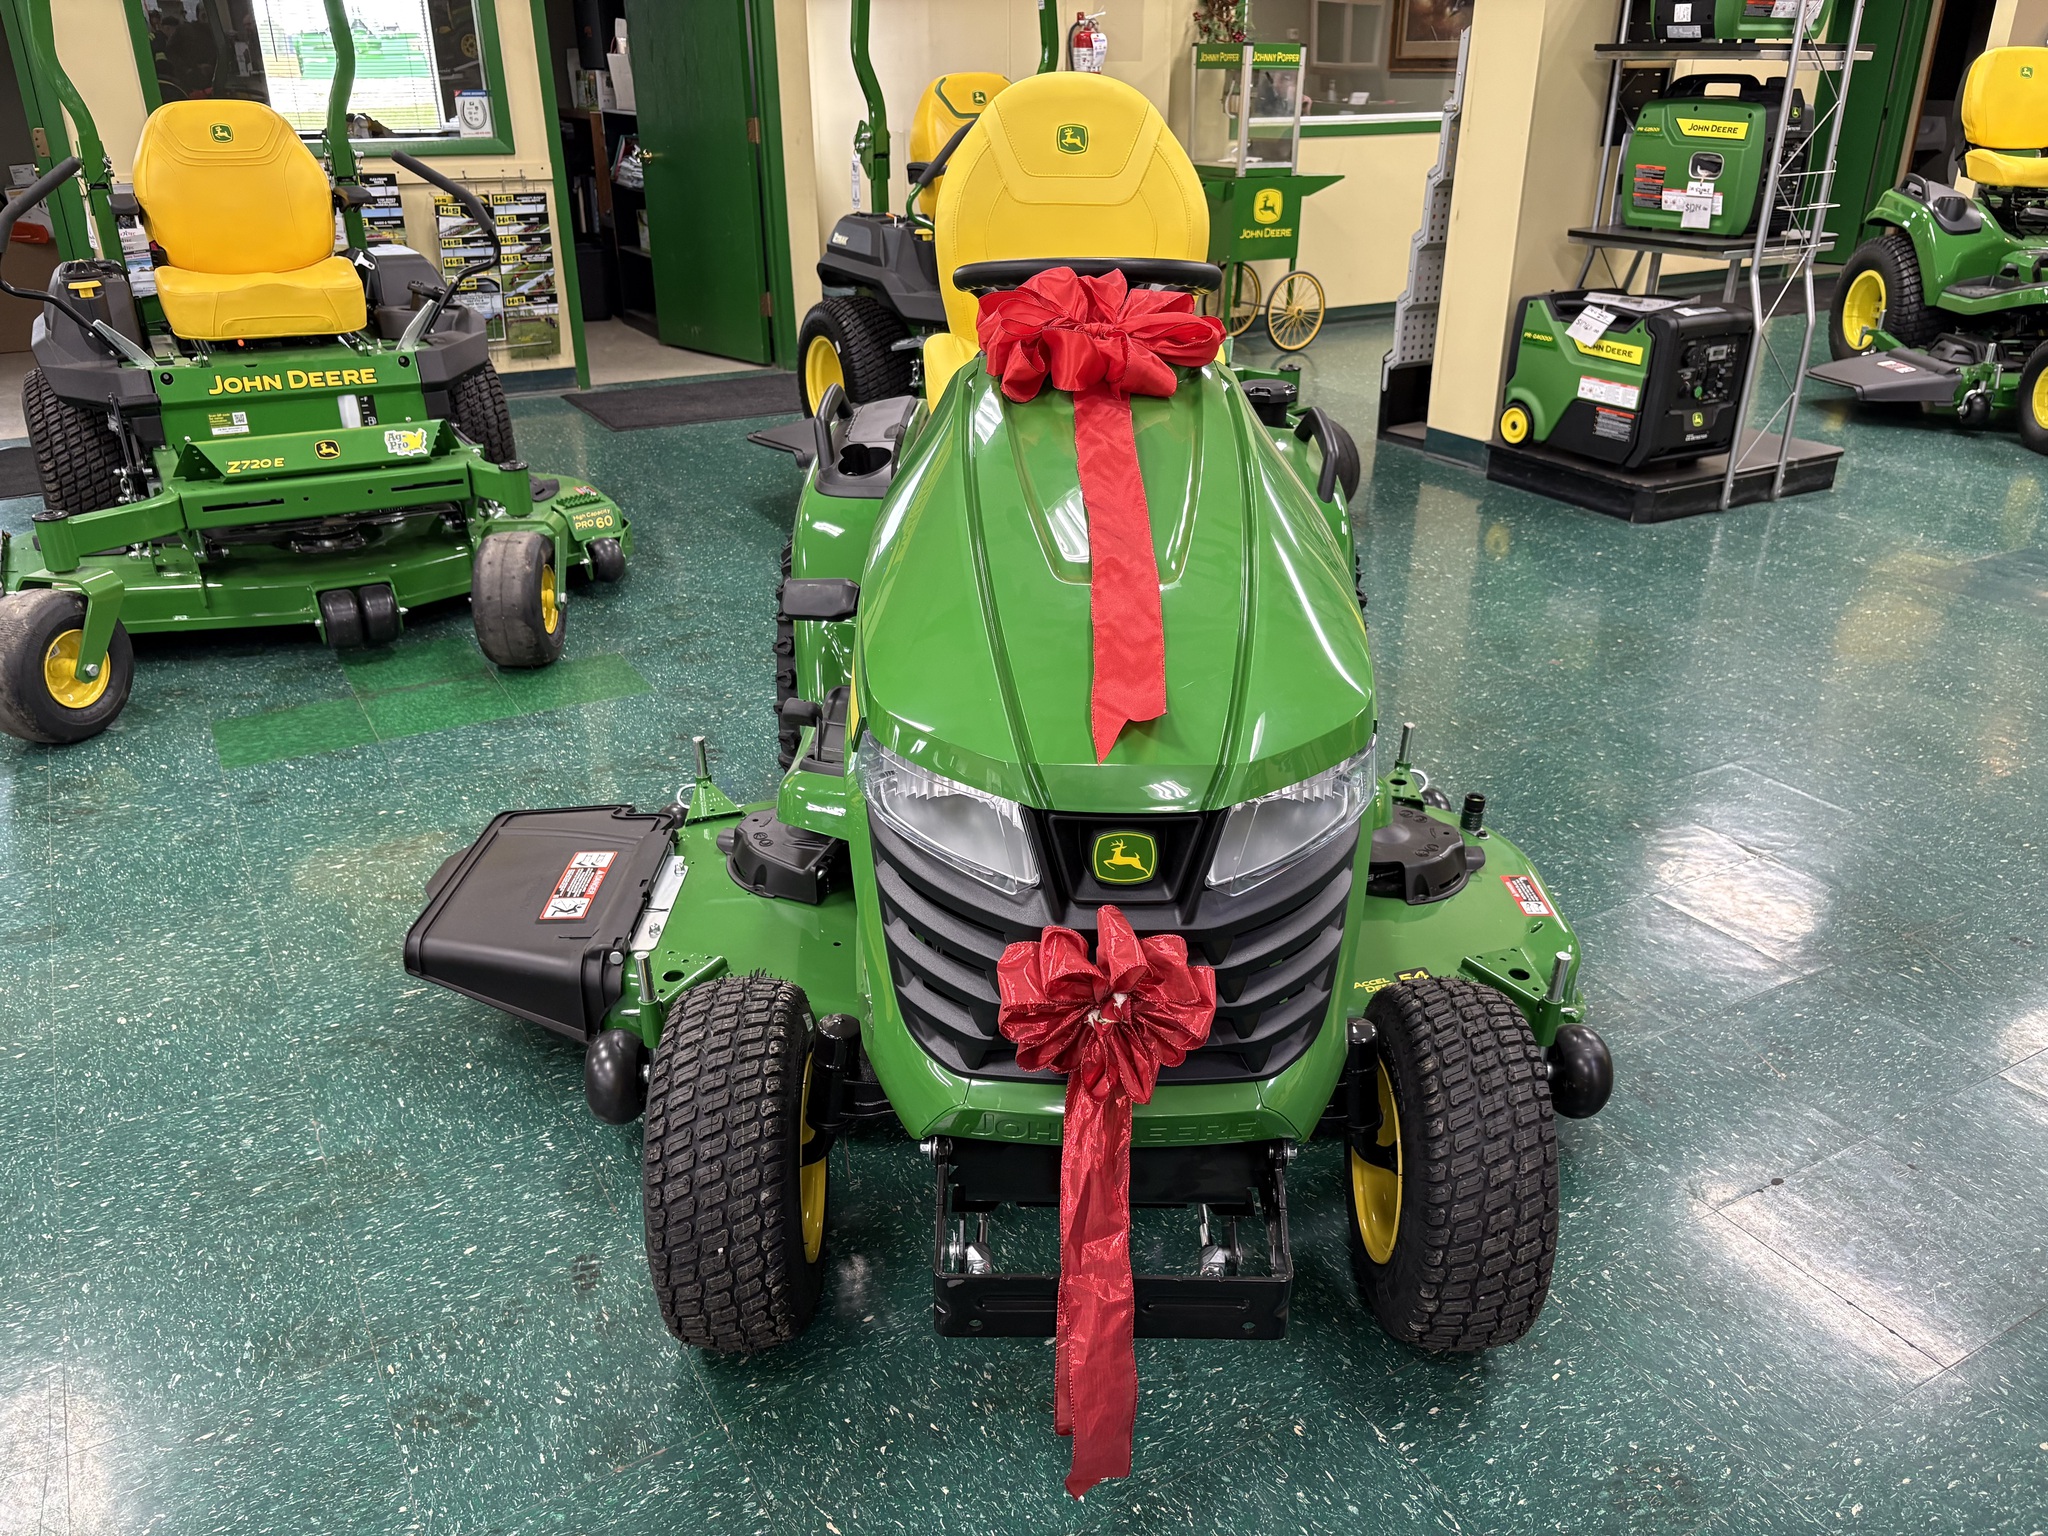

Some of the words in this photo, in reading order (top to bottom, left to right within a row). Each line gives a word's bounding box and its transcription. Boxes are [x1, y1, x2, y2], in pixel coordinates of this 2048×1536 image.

[1200, 51, 1220, 62] JOHNNY
[1220, 51, 1240, 62] POPPER
[1253, 51, 1276, 62] JOHNNY
[1276, 51, 1300, 62] POPPER
[1688, 122, 1710, 132] JOHN
[1710, 124, 1738, 134] DEERE
[1240, 228, 1264, 239] JOHN
[1264, 228, 1292, 238] DEERE
[1606, 345, 1634, 358] DEERE
[208, 374, 284, 396] JOHN
[286, 368, 378, 390] DEERE
[390, 442, 409, 450] Pro
[575, 519, 594, 530] PRO
[596, 514, 613, 529] 60
[1354, 978, 1390, 990] ACCEL
[970, 1113, 1061, 1142] JOH
[1140, 1121, 1257, 1143] EERE
